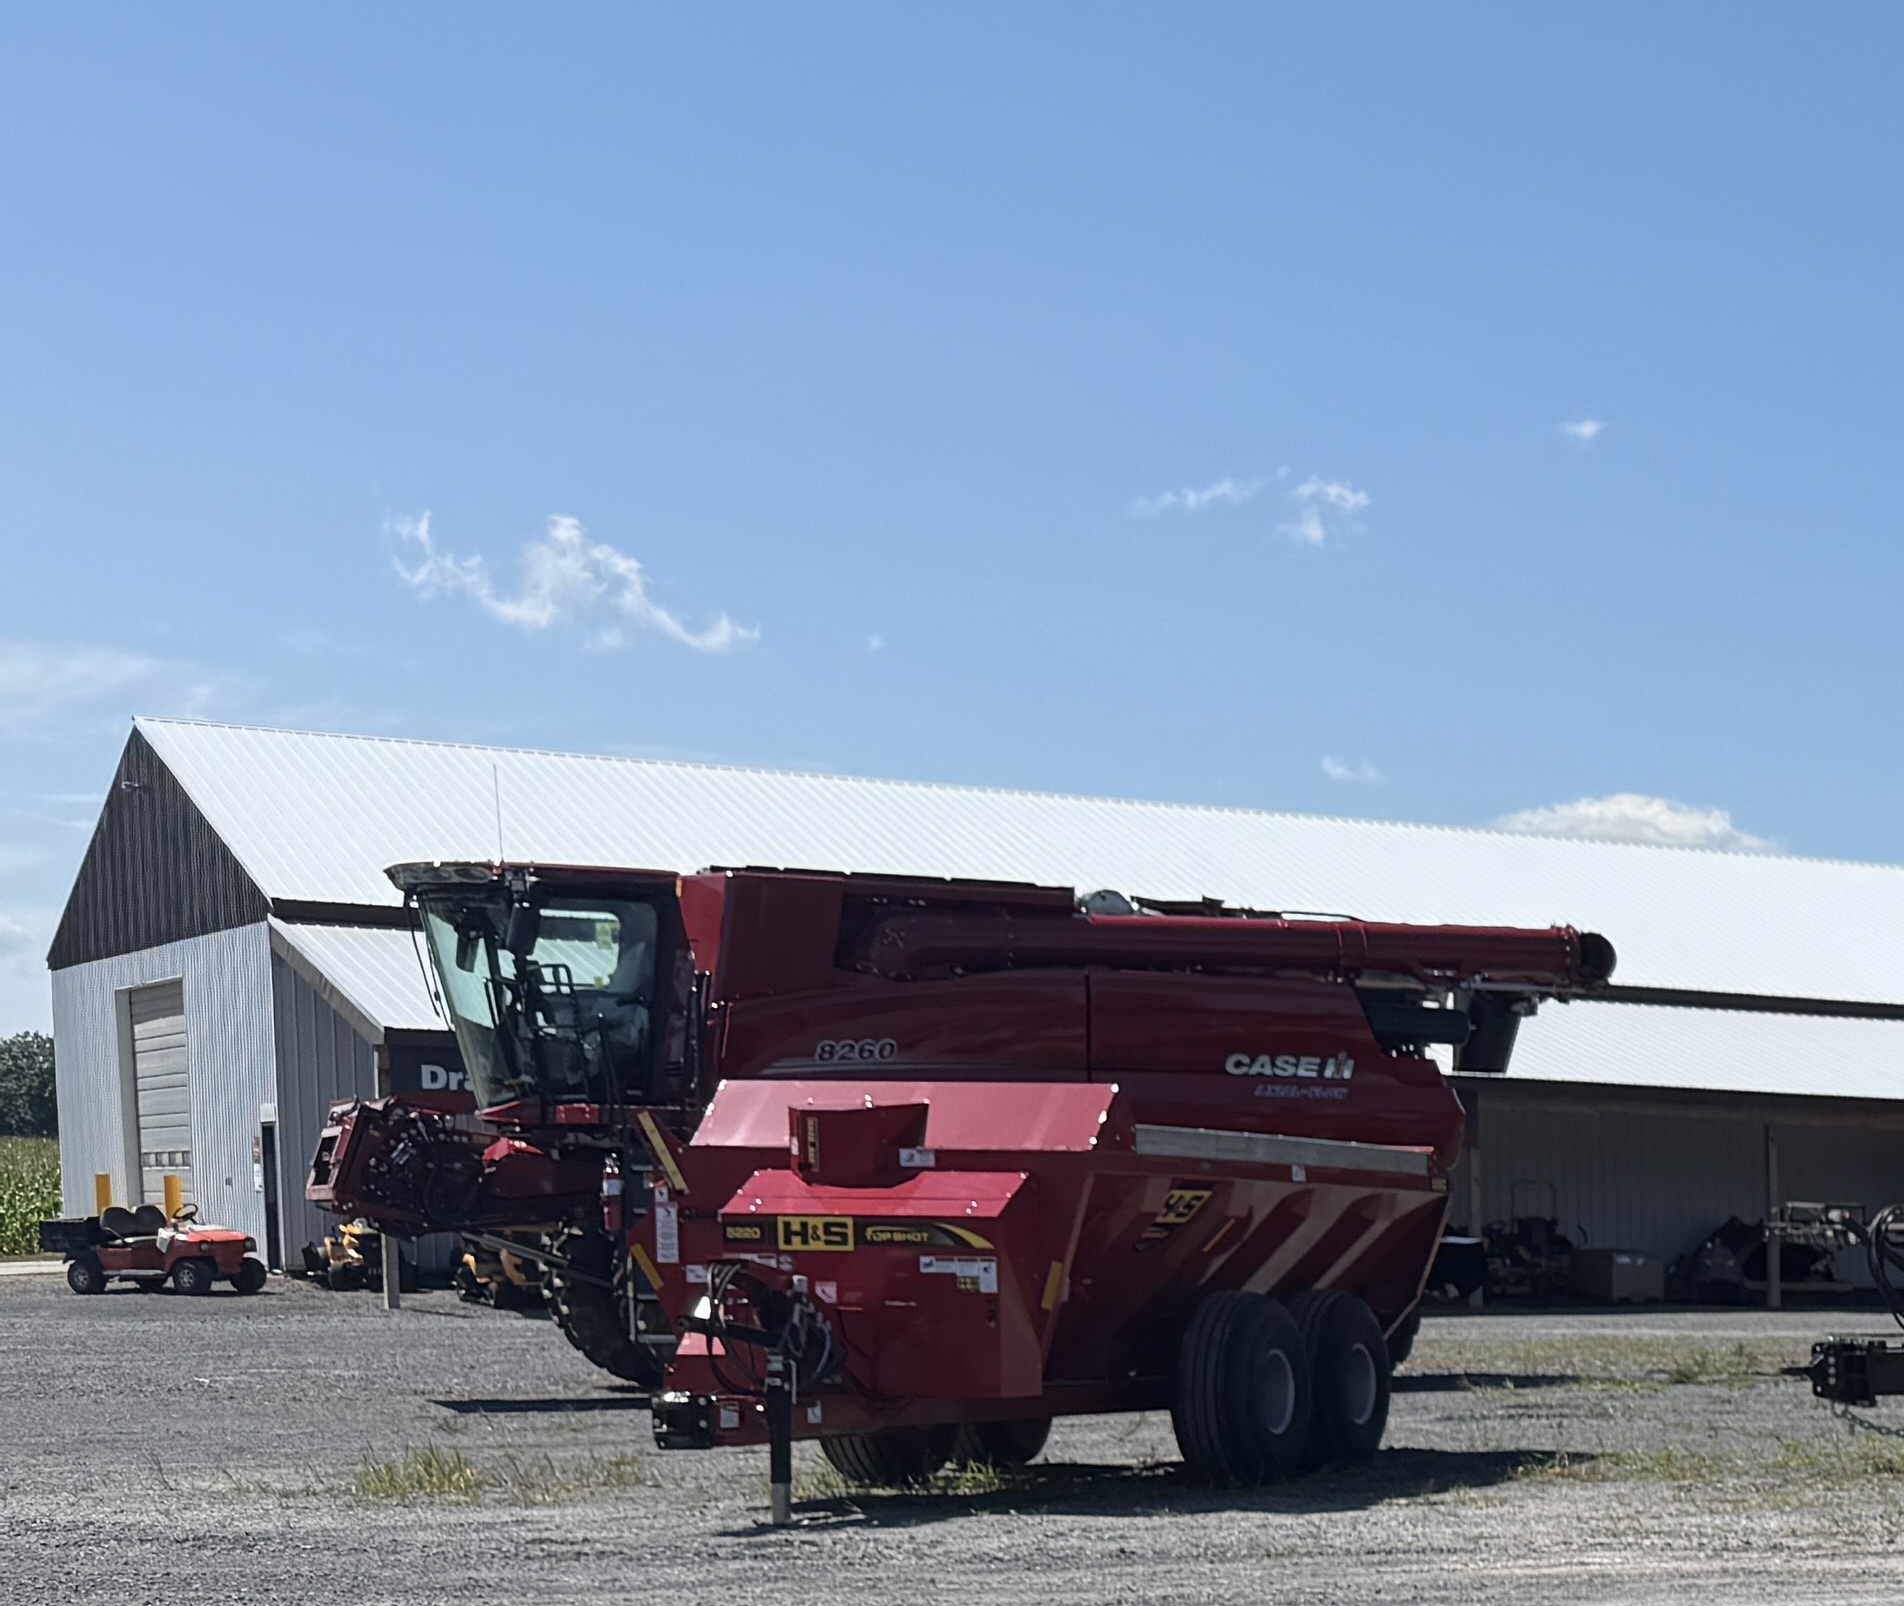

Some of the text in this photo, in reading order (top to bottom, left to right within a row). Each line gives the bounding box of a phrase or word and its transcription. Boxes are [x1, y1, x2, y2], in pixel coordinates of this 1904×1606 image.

[815, 1038, 898, 1062] 8260
[1224, 1052, 1322, 1078] CASE
[781, 1219, 850, 1247] H&S
